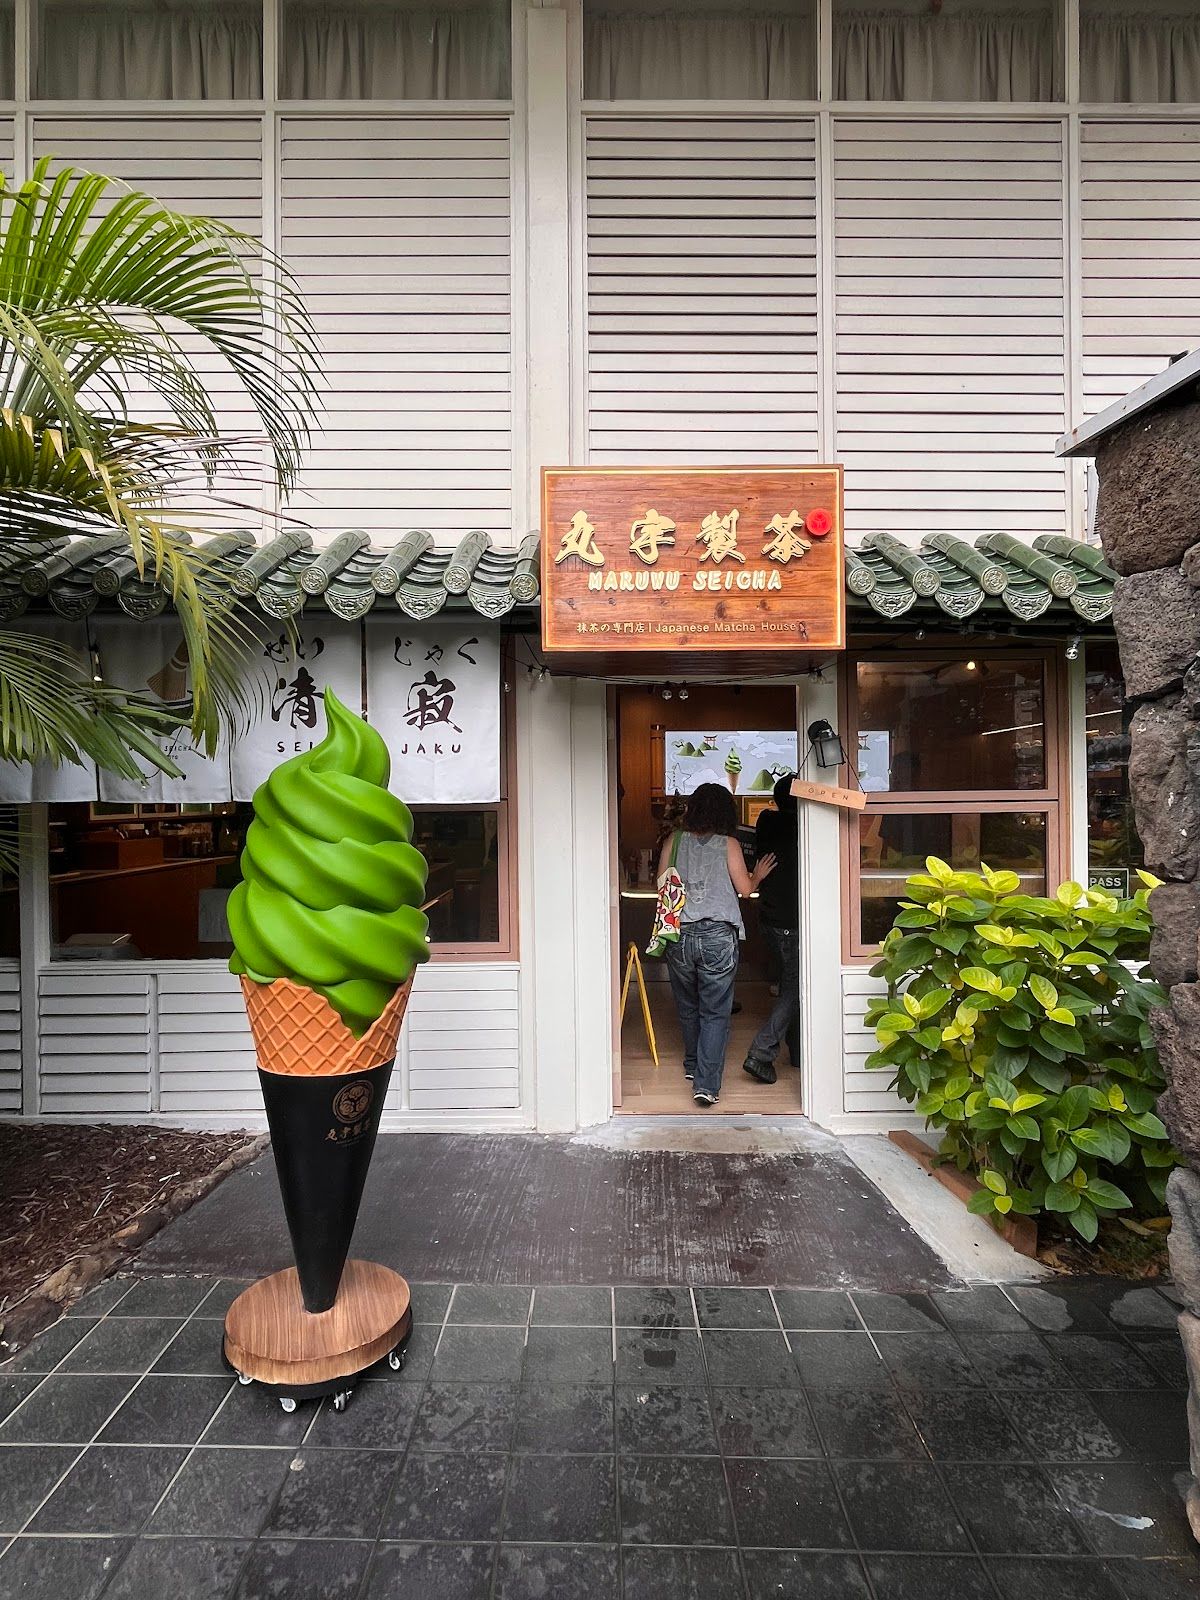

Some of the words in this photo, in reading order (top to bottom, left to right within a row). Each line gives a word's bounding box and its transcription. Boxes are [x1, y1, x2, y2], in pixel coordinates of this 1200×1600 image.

[588, 569, 680, 592] MARUWU
[692, 569, 782, 592] SEICHA
[576, 622, 645, 634] 抹茶の専門店
[655, 623, 710, 634] Japanese
[714, 622, 756, 633] Matcha
[761, 621, 796, 631] House
[394, 636, 479, 666] じゃく
[271, 667, 325, 729] 清
[402, 670, 463, 733] 寂
[401, 743, 461, 755] JAKU
[807, 787, 849, 801] OPEN
